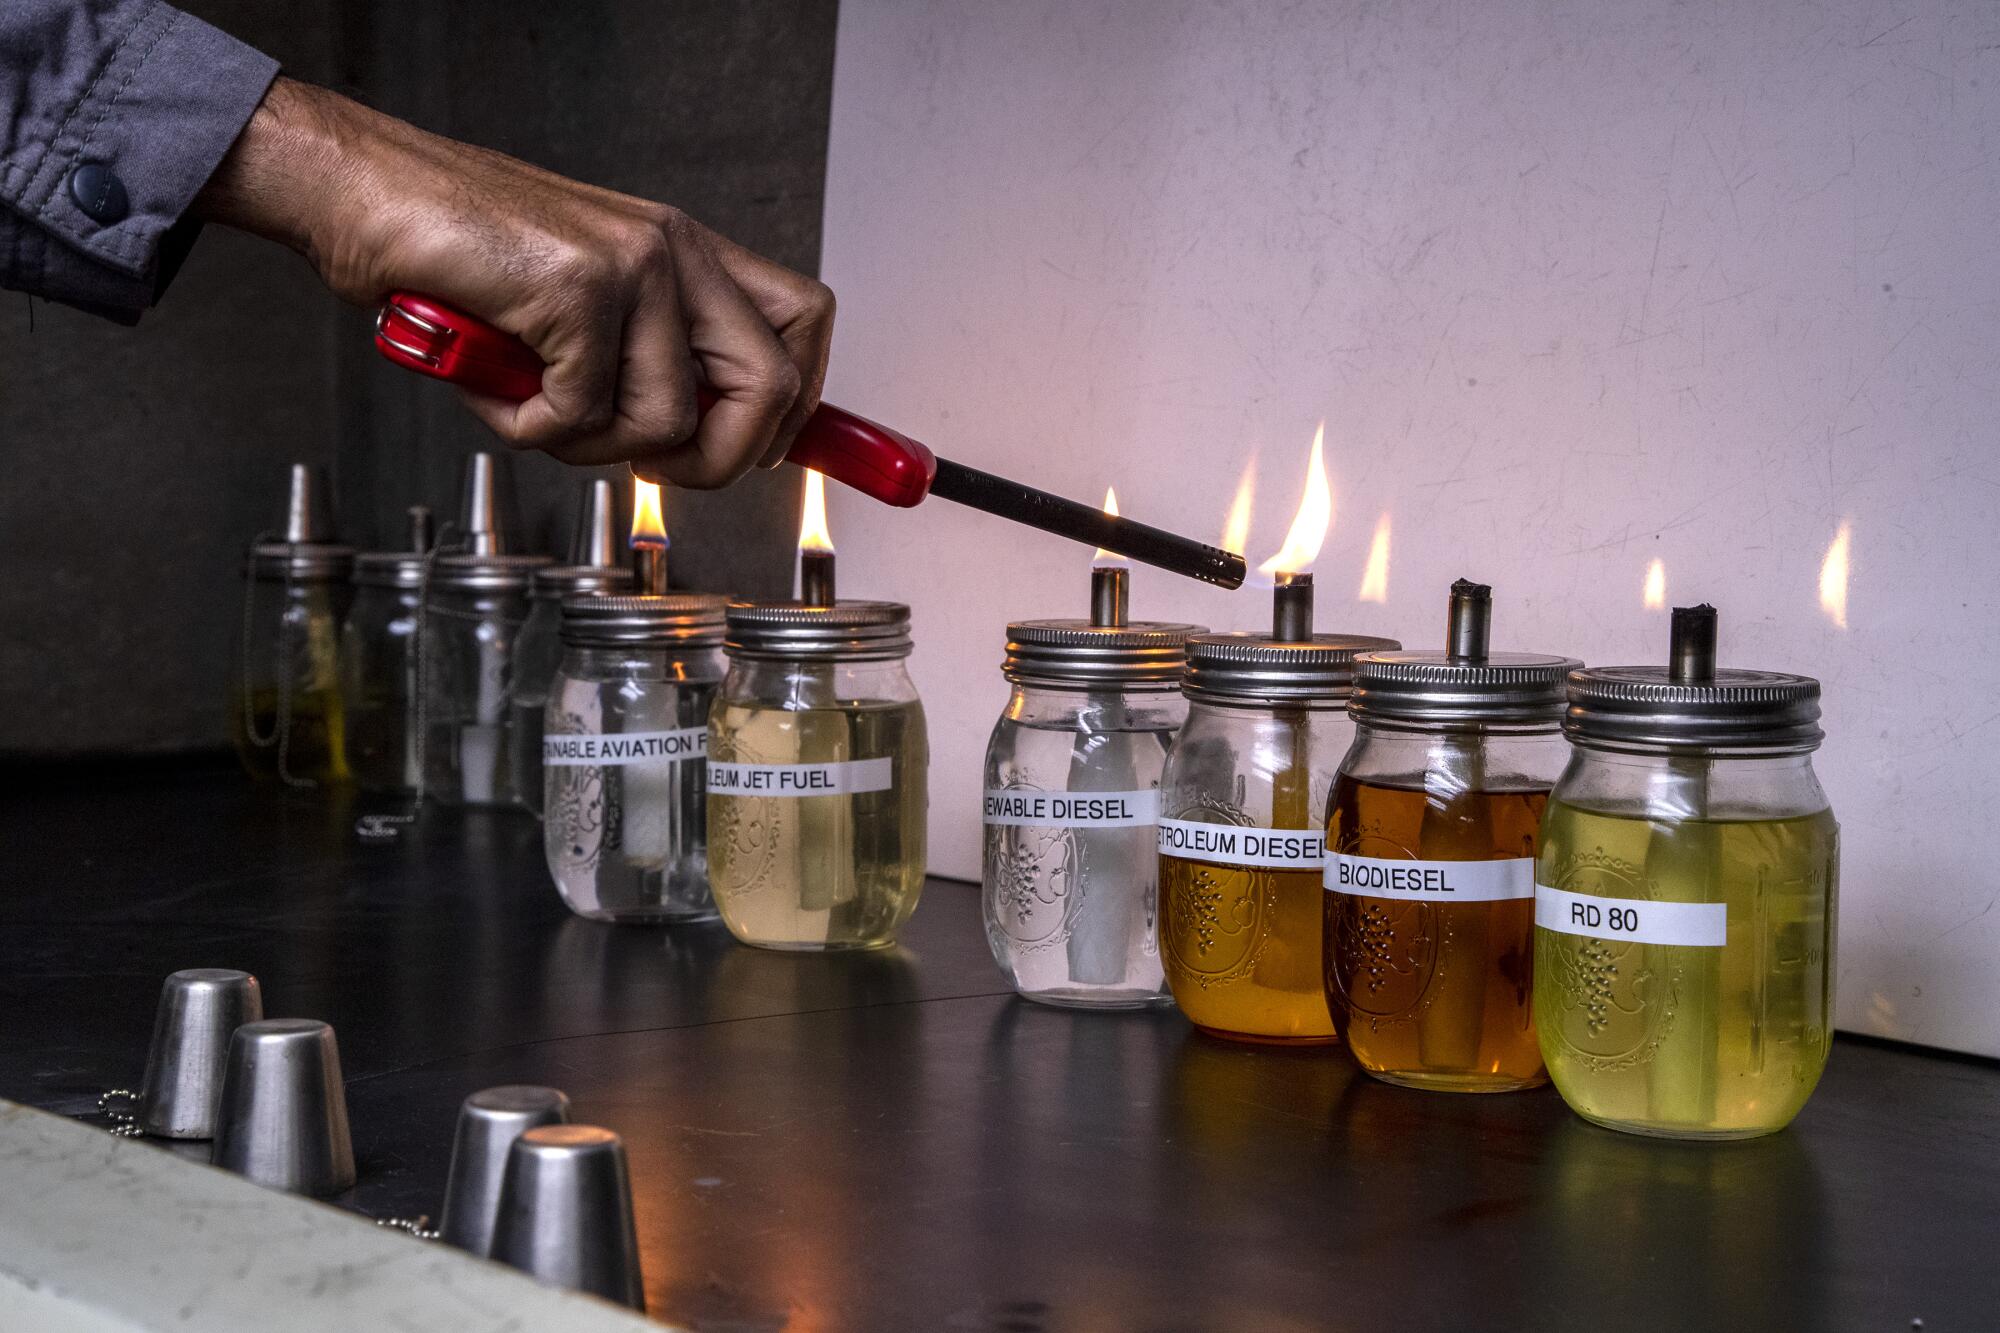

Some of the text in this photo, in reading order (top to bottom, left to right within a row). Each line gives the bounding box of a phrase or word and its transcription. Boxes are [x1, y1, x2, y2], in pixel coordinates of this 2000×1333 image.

[601, 736, 692, 758] AVIATION
[744, 770, 774, 789] JET
[780, 769, 835, 789] FUEL
[1053, 799, 1133, 820] DIESEL
[1244, 835, 1324, 859] DIESEL
[1340, 863, 1455, 892] BIODIESEL
[1572, 902, 1638, 932] RD 80
